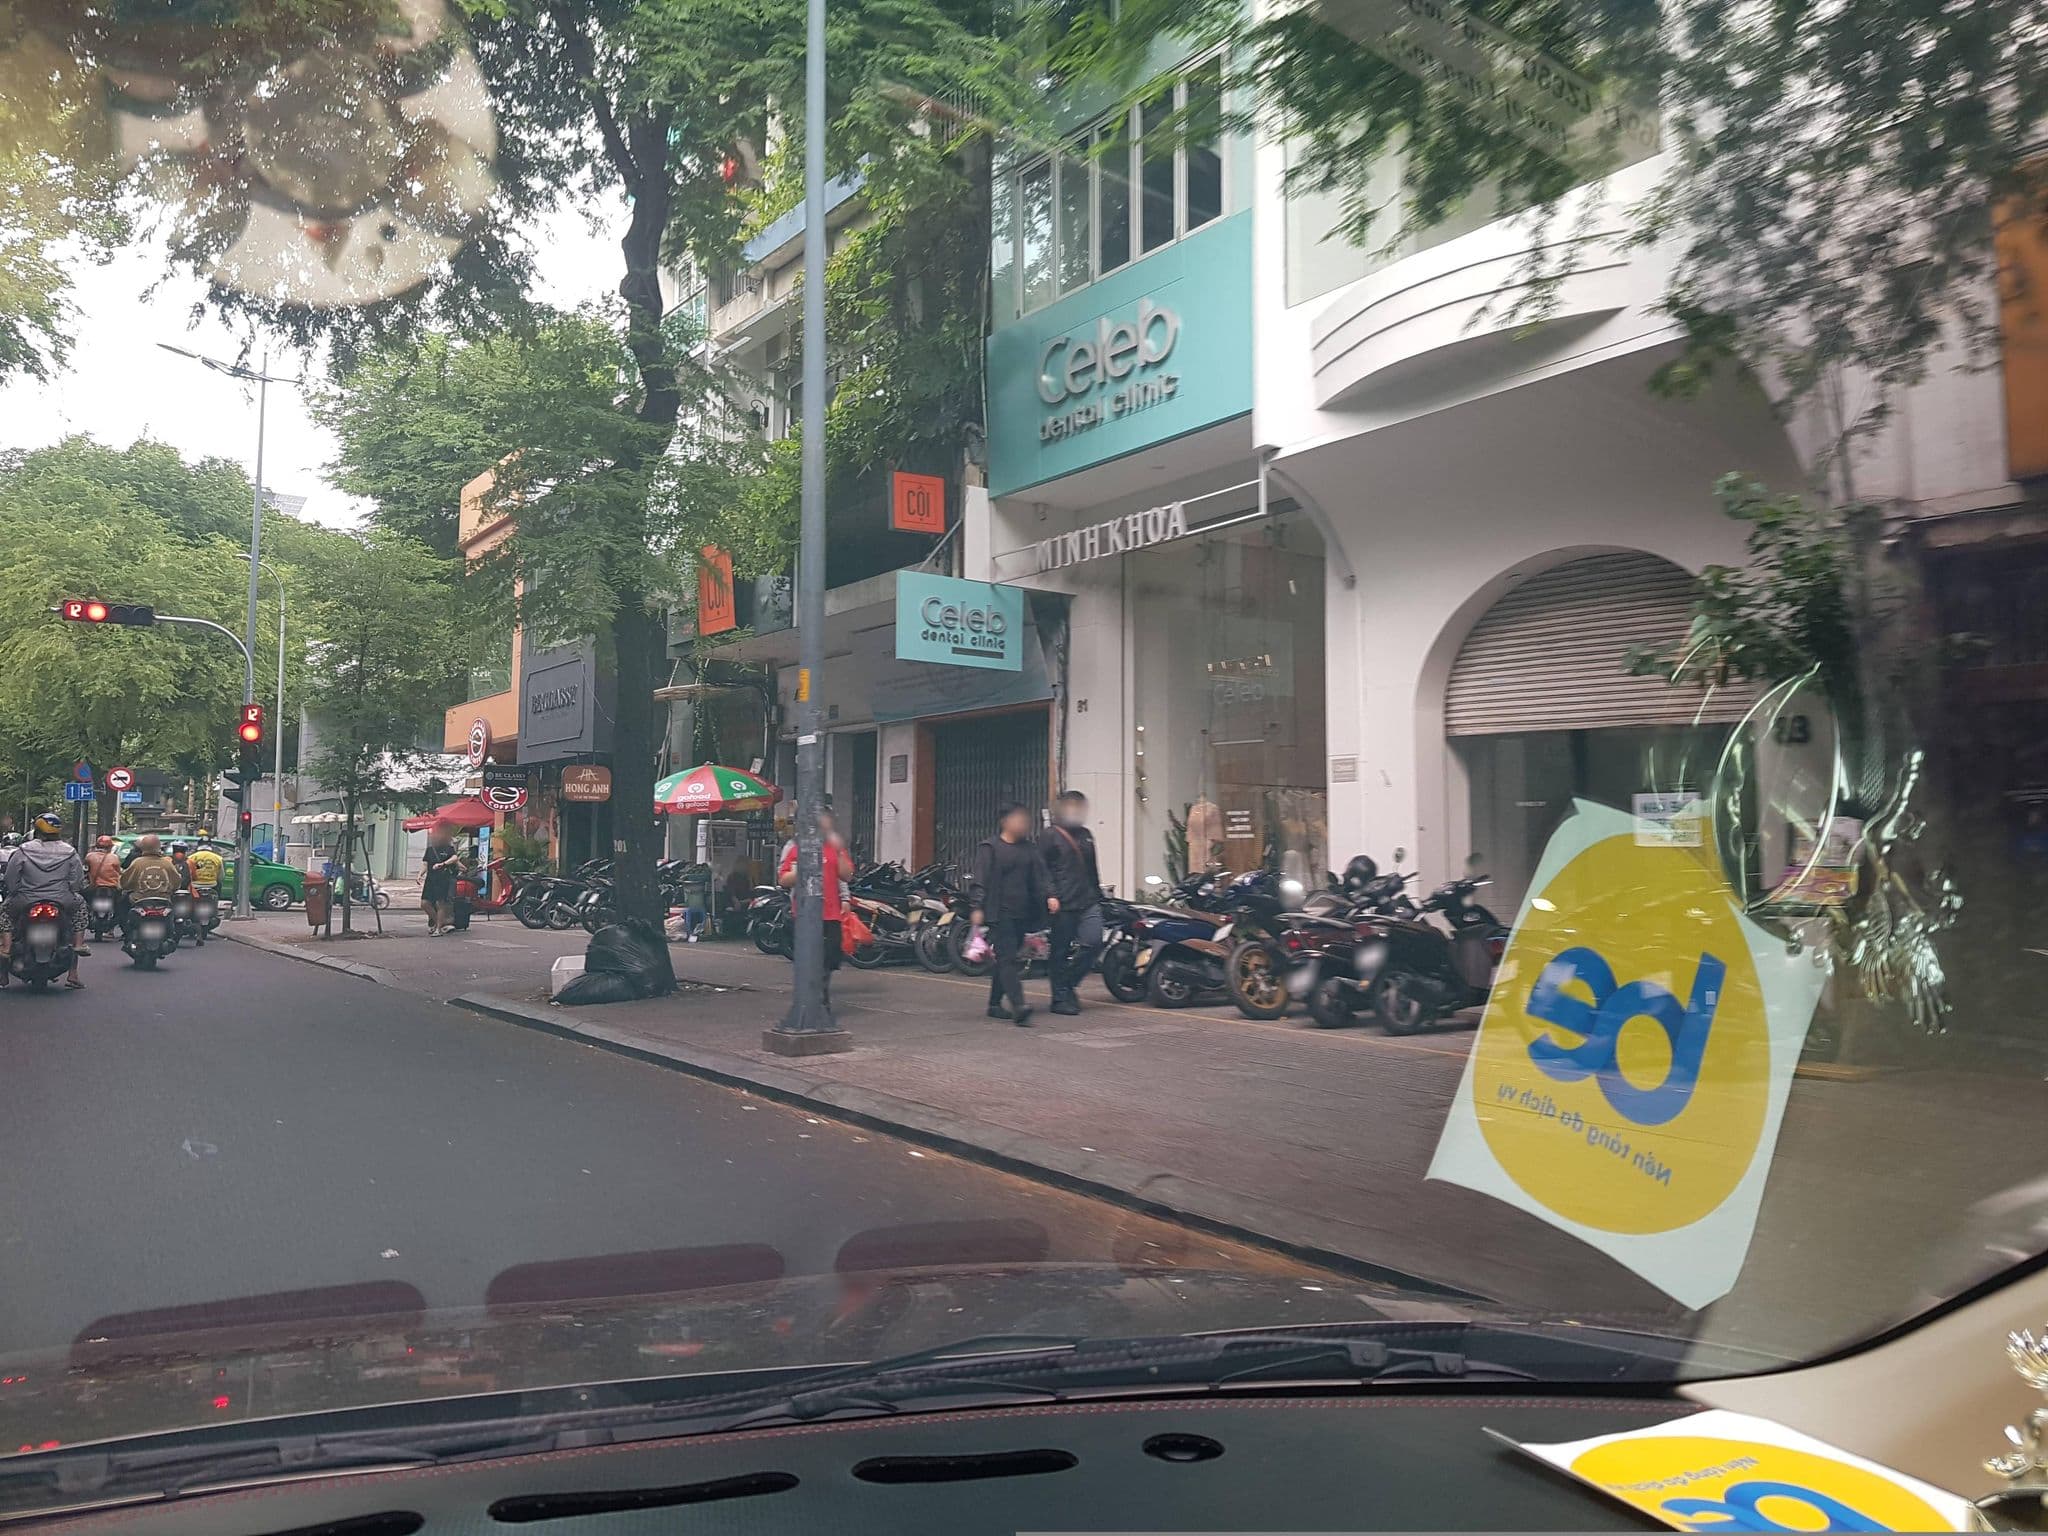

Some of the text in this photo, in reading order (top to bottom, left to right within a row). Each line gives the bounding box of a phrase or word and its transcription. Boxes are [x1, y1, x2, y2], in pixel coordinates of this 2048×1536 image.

[1038, 298, 1179, 404] Celeb
[1040, 375, 1179, 441] dental clinic
[1035, 501, 1188, 572] MINH KHOA
[921, 596, 1008, 637] Celeb
[921, 628, 1006, 649] dental clinic
[488, 800, 520, 810] COFFEE
[565, 783, 609, 794] HONG ANH
